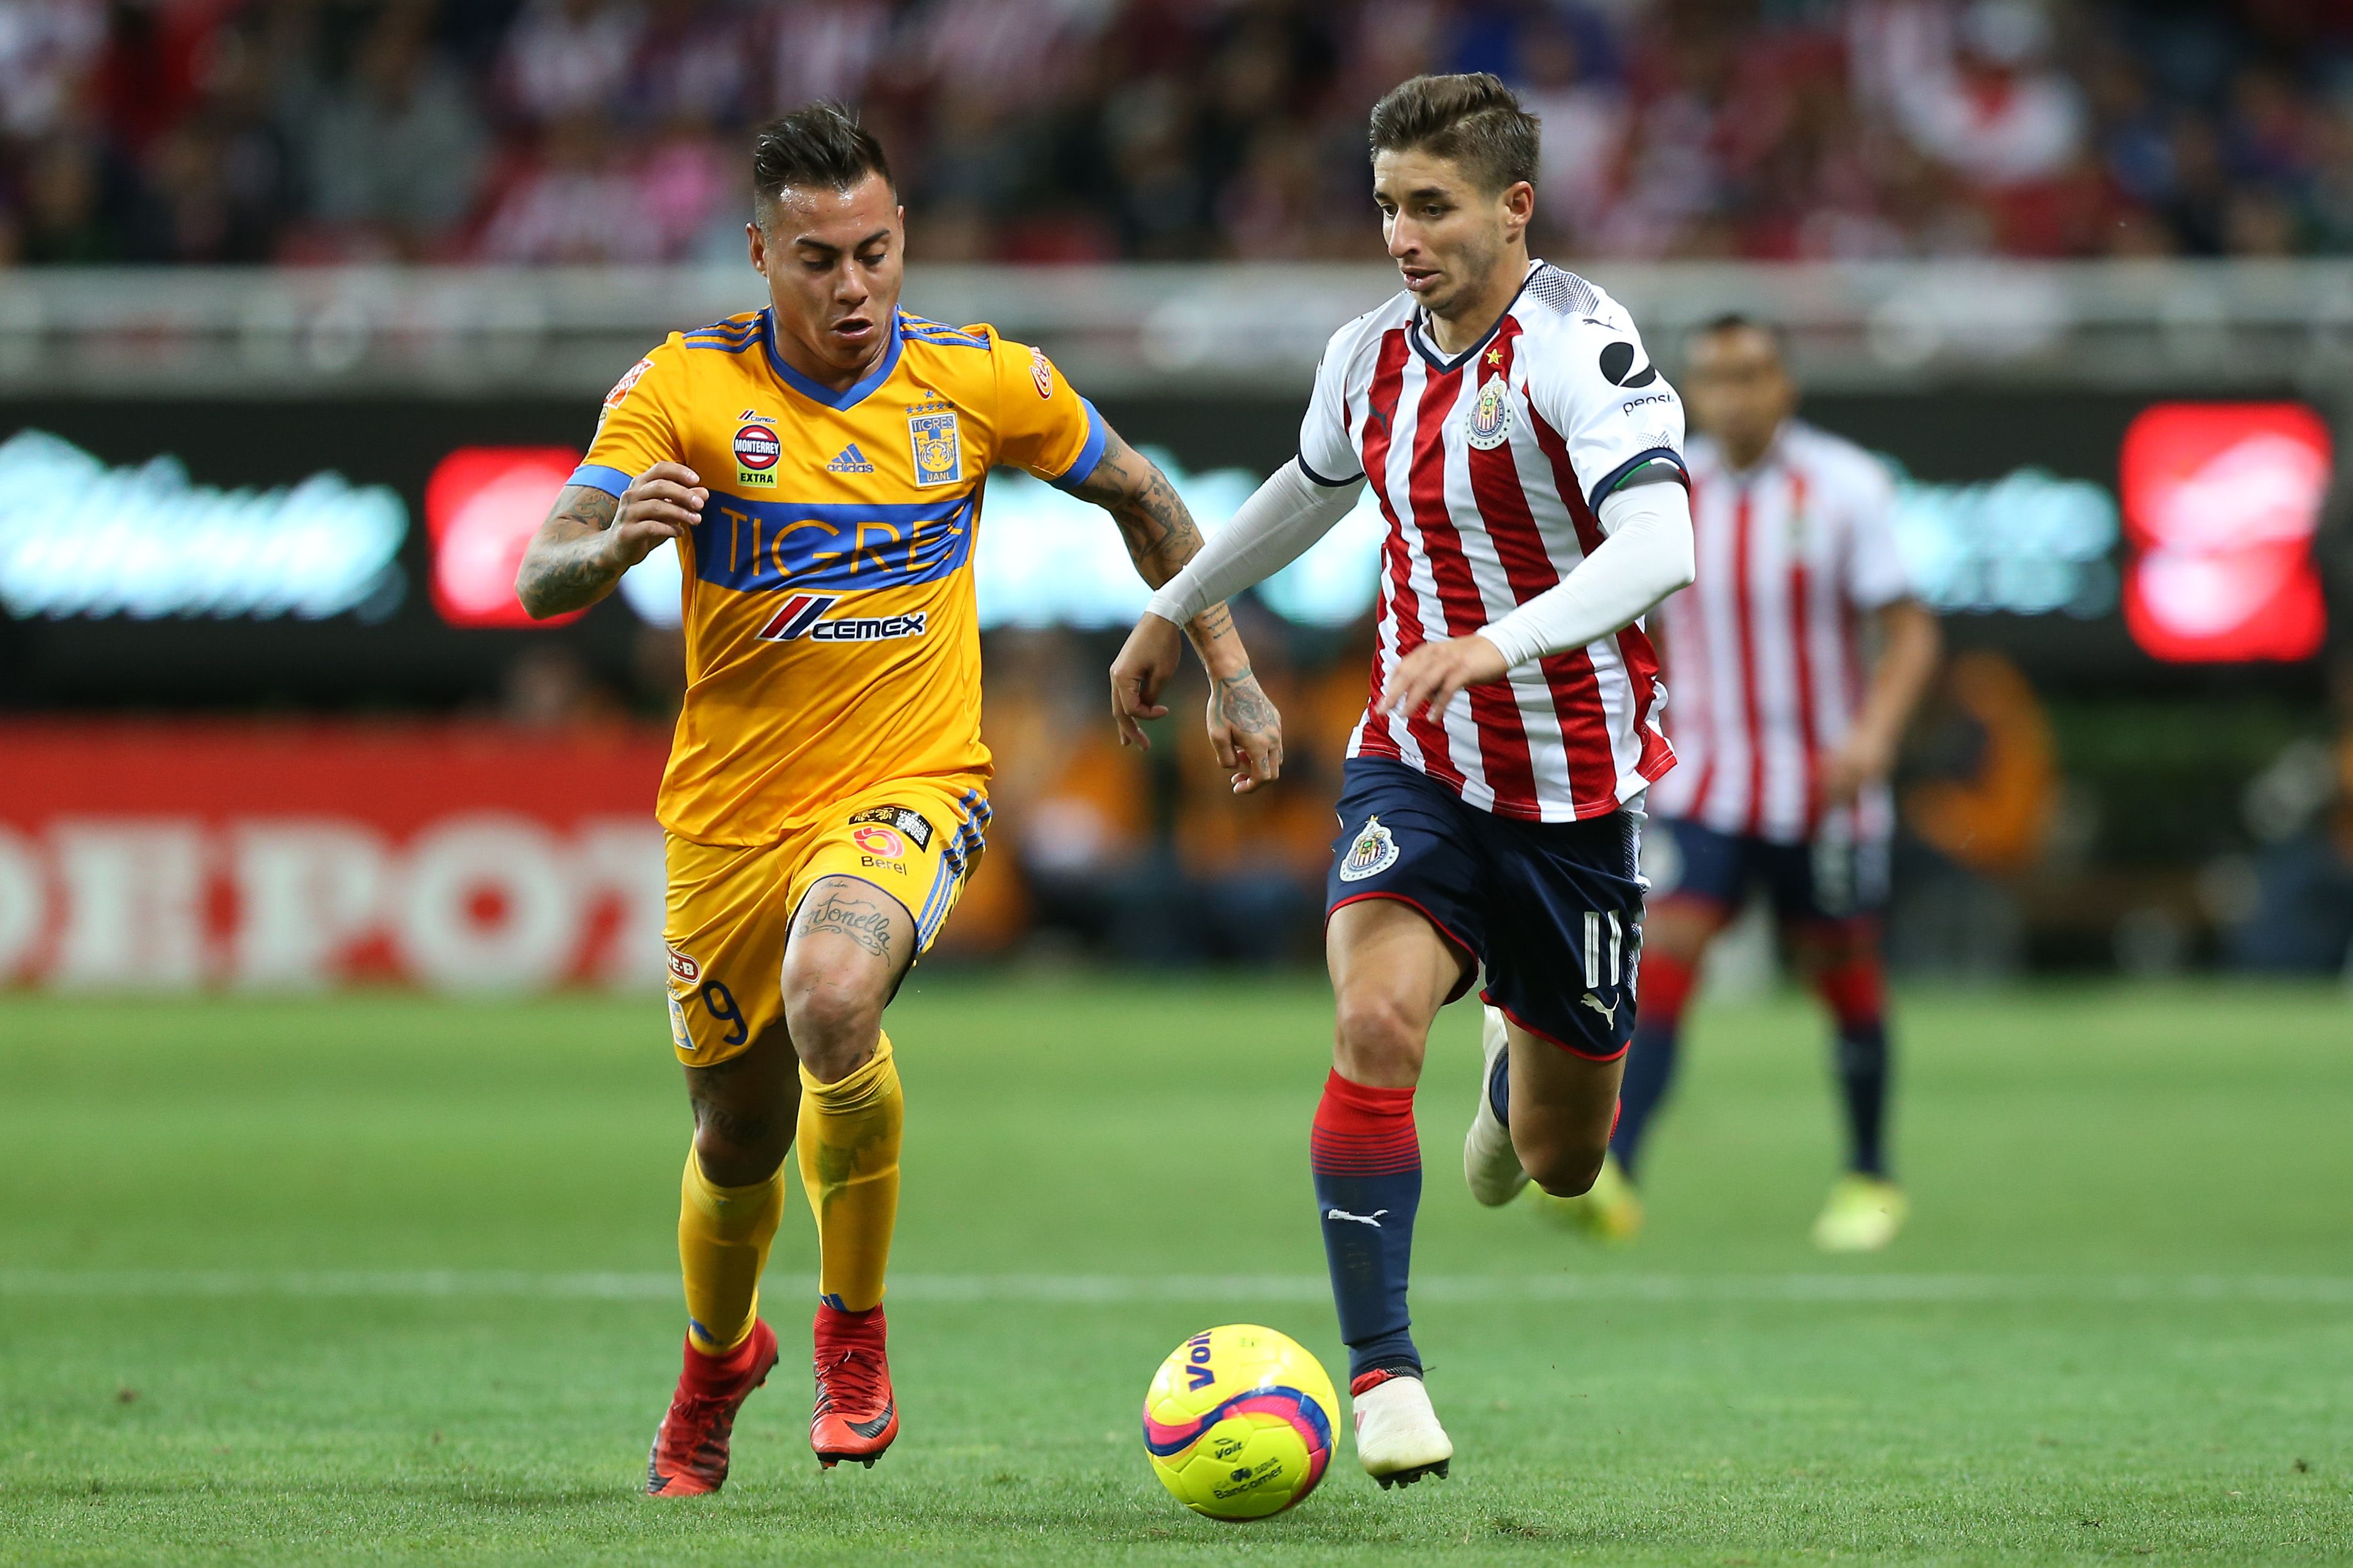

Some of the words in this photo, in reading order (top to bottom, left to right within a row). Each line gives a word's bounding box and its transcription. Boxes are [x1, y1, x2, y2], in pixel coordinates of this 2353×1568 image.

[912, 417, 954, 431] TIGRES
[734, 439, 779, 454] MONTERREY
[827, 463, 874, 473] adidas
[927, 472, 951, 482] UANL
[740, 473, 774, 483] EXTRA
[812, 614, 924, 640] CEMEX
[861, 855, 907, 876] Berel
[1584, 909, 1622, 989] 11
[702, 980, 749, 1046] 9
[1214, 1465, 1282, 1499] Bancomer
